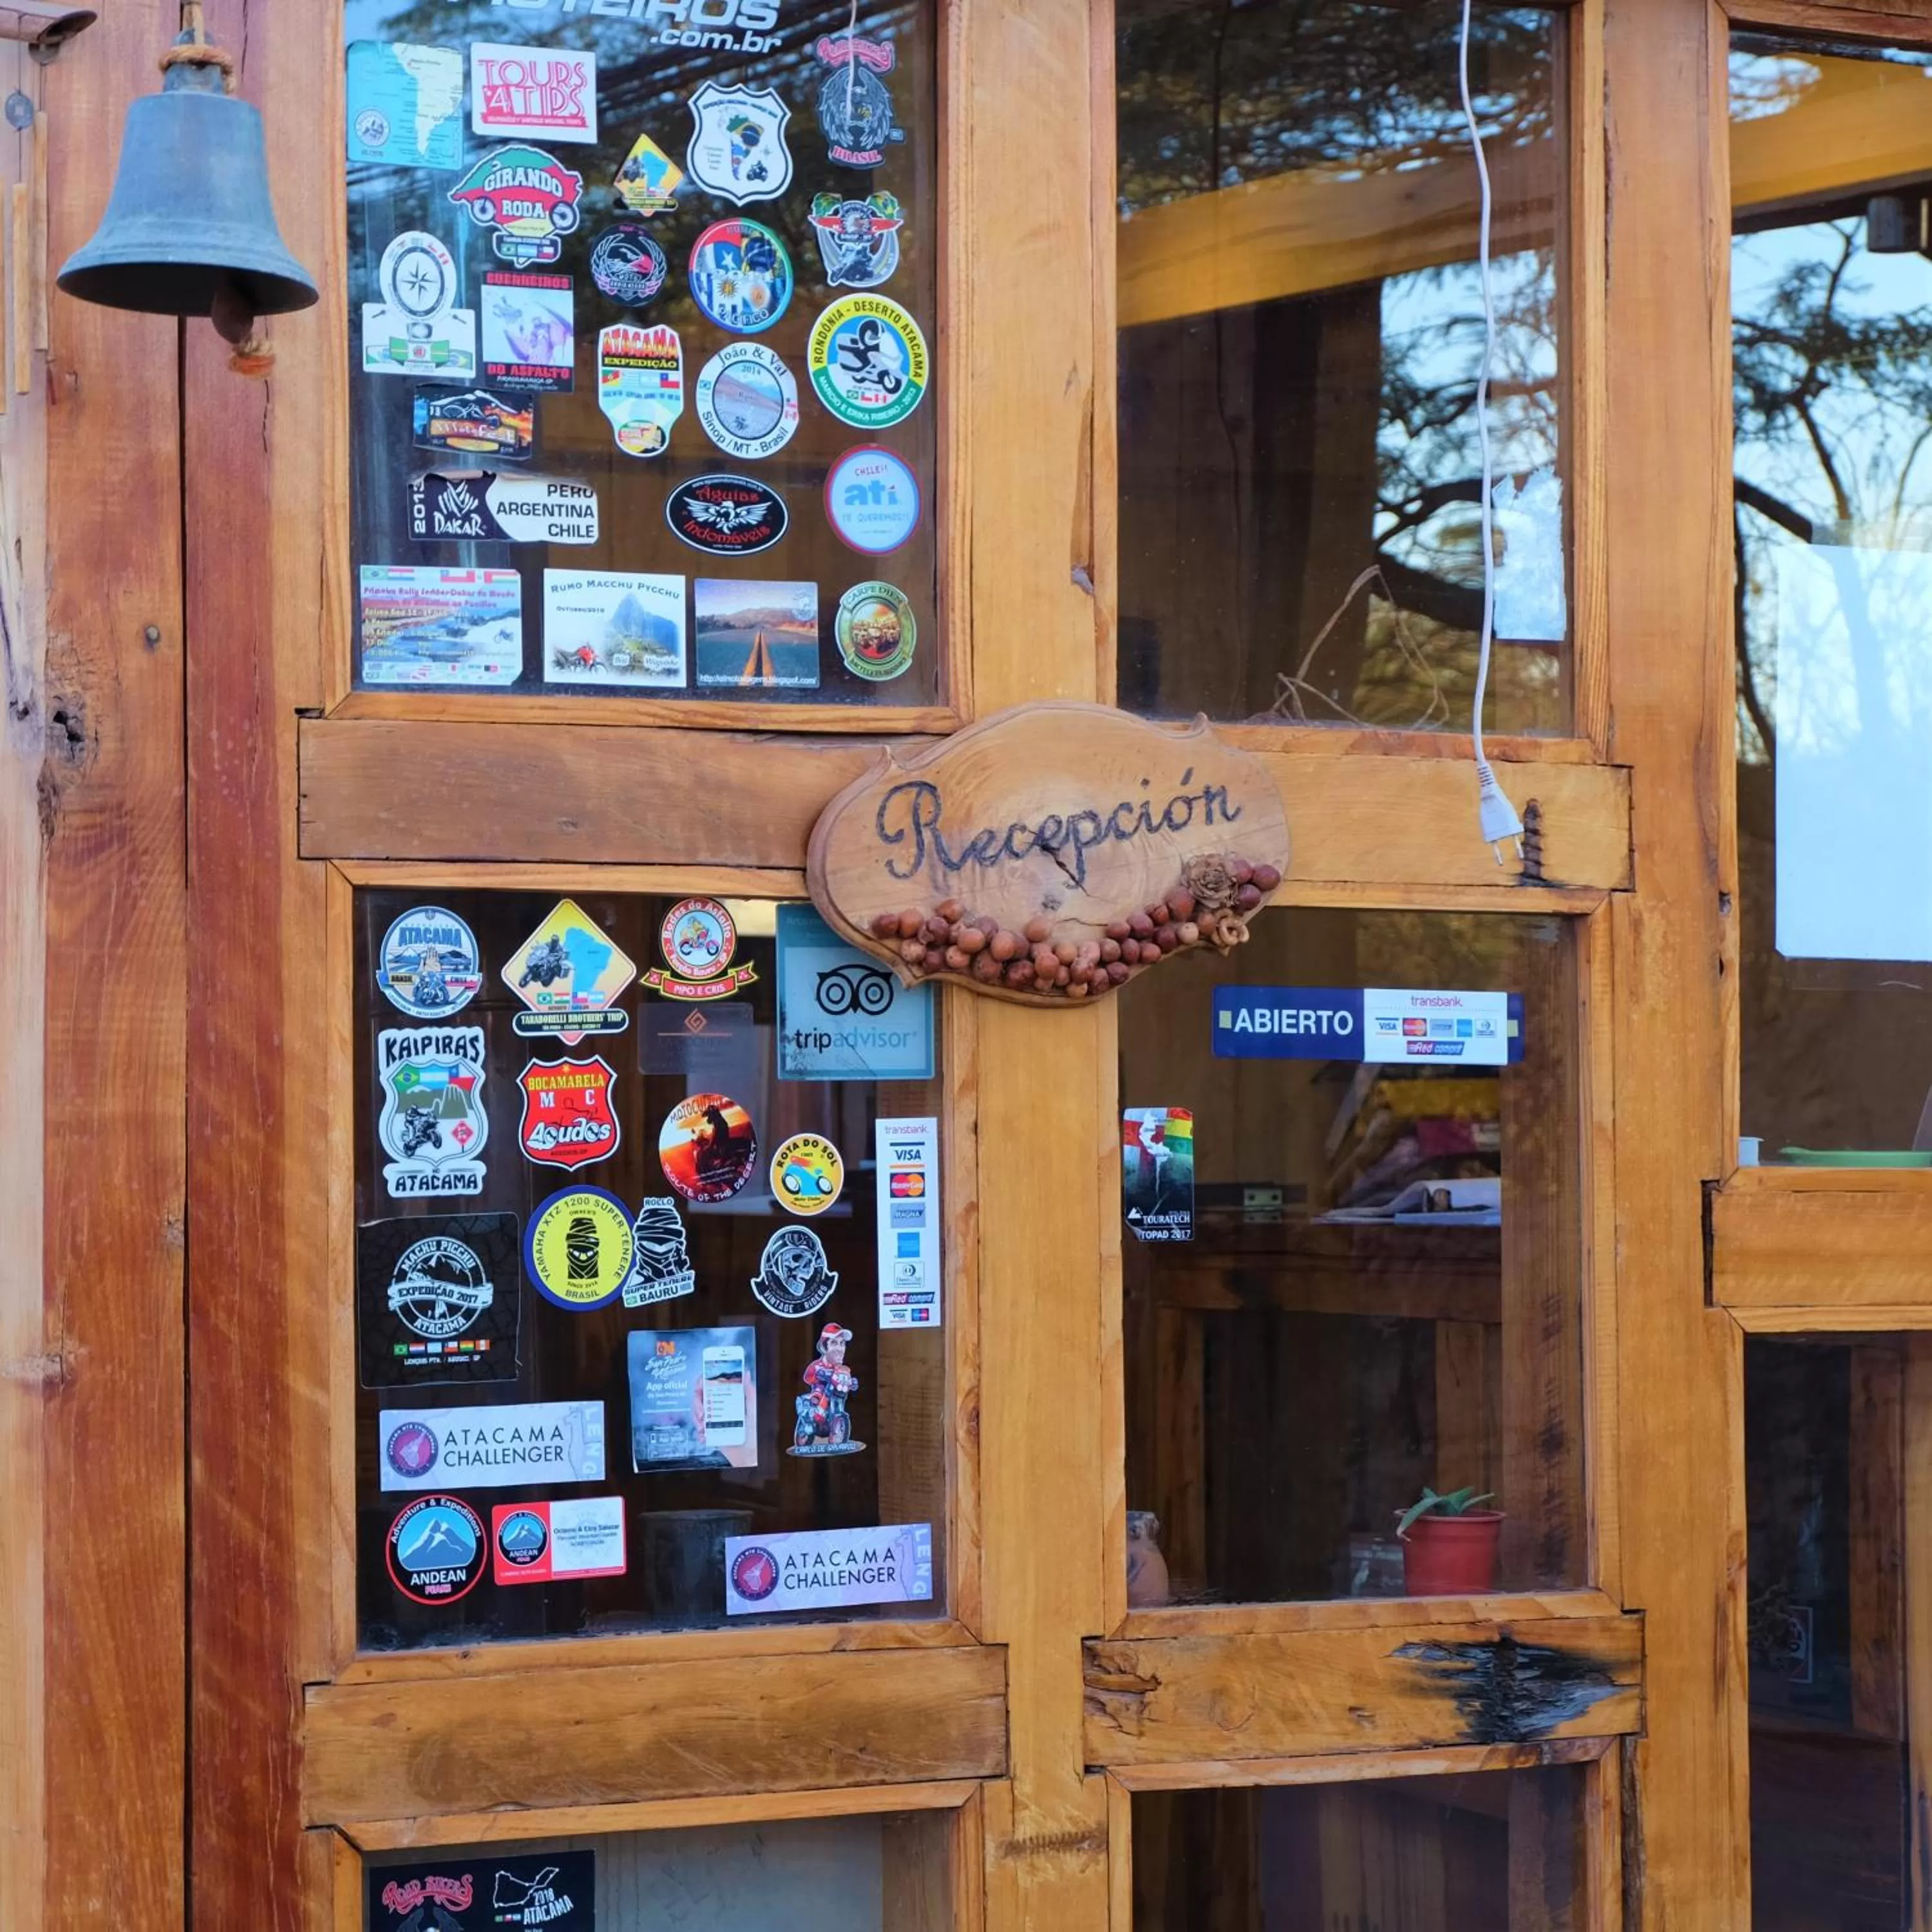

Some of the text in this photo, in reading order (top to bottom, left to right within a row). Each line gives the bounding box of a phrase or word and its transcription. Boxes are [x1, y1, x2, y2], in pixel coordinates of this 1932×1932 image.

[650, 28, 782, 53] .com.br
[478, 59, 587, 88] TOURS
[484, 167, 563, 198] GIRANDO
[502, 200, 546, 218] RODA
[602, 328, 679, 359] ATACAMA
[854, 301, 902, 325] DESERTO
[900, 323, 923, 379] ATACAMA
[604, 357, 677, 369] EXPEDIÇÃO
[716, 345, 788, 377] João & Val
[703, 411, 789, 454] Sinop MT Brasil
[547, 484, 594, 498] PERU
[413, 479, 426, 534] 2013
[497, 502, 594, 518] ARGENTINA
[433, 511, 484, 536] DAKAR
[548, 524, 594, 538] CHILE
[551, 580, 680, 599] RUMO MACCHU PYCCHU
[875, 767, 1243, 891] Recepción
[688, 900, 701, 911] do
[399, 927, 462, 949] ATACAMA
[674, 985, 696, 996] PIPO
[697, 985, 703, 994] E
[607, 1012, 623, 1022] TRIP
[1235, 1009, 1353, 1035] ABIERTO
[1379, 1021, 1397, 1031] VISA
[794, 1027, 910, 1054] tripadvisor
[385, 1034, 480, 1068] KAIPIRAS
[528, 1074, 605, 1090] BOCAMARELA
[540, 1089, 596, 1108] M C
[803, 1139, 819, 1148] DO
[821, 1145, 838, 1168] SOL
[895, 1149, 922, 1160] VISA
[697, 1193, 710, 1202] OF
[714, 1188, 733, 1201] THE
[734, 1139, 757, 1189] DESERT
[395, 1174, 478, 1192] ATACAMA
[645, 1197, 674, 1206] ROLLO
[1142, 1215, 1191, 1224] TOURATECH
[535, 1197, 630, 1282] YAMAHA XTZ 1200 SUPER TENERE
[1141, 1229, 1191, 1240] TOPAD 2017
[401, 1241, 476, 1271] MACHU PICCHU
[457, 1291, 479, 1303] 2017
[565, 1290, 600, 1300] BRASIL
[623, 1282, 656, 1295] SUPER
[639, 1285, 679, 1303] BAURU
[764, 1285, 829, 1313] VINTAGE RIDERS
[413, 1315, 467, 1334] ATACAMA
[647, 1382, 666, 1391] App
[444, 1425, 564, 1447] ATACAMA
[444, 1446, 564, 1467] CHALLENGER
[390, 1501, 426, 1544] Adventure
[440, 1499, 482, 1538] Expeditions
[509, 1549, 538, 1558] ANDEAN
[784, 1547, 896, 1570] ATACAMA
[410, 1569, 466, 1586] ANDEAN
[784, 1566, 896, 1590] CHALLENGER
[533, 1888, 553, 1906] 2018
[522, 1895, 574, 1925] ATACAMA
